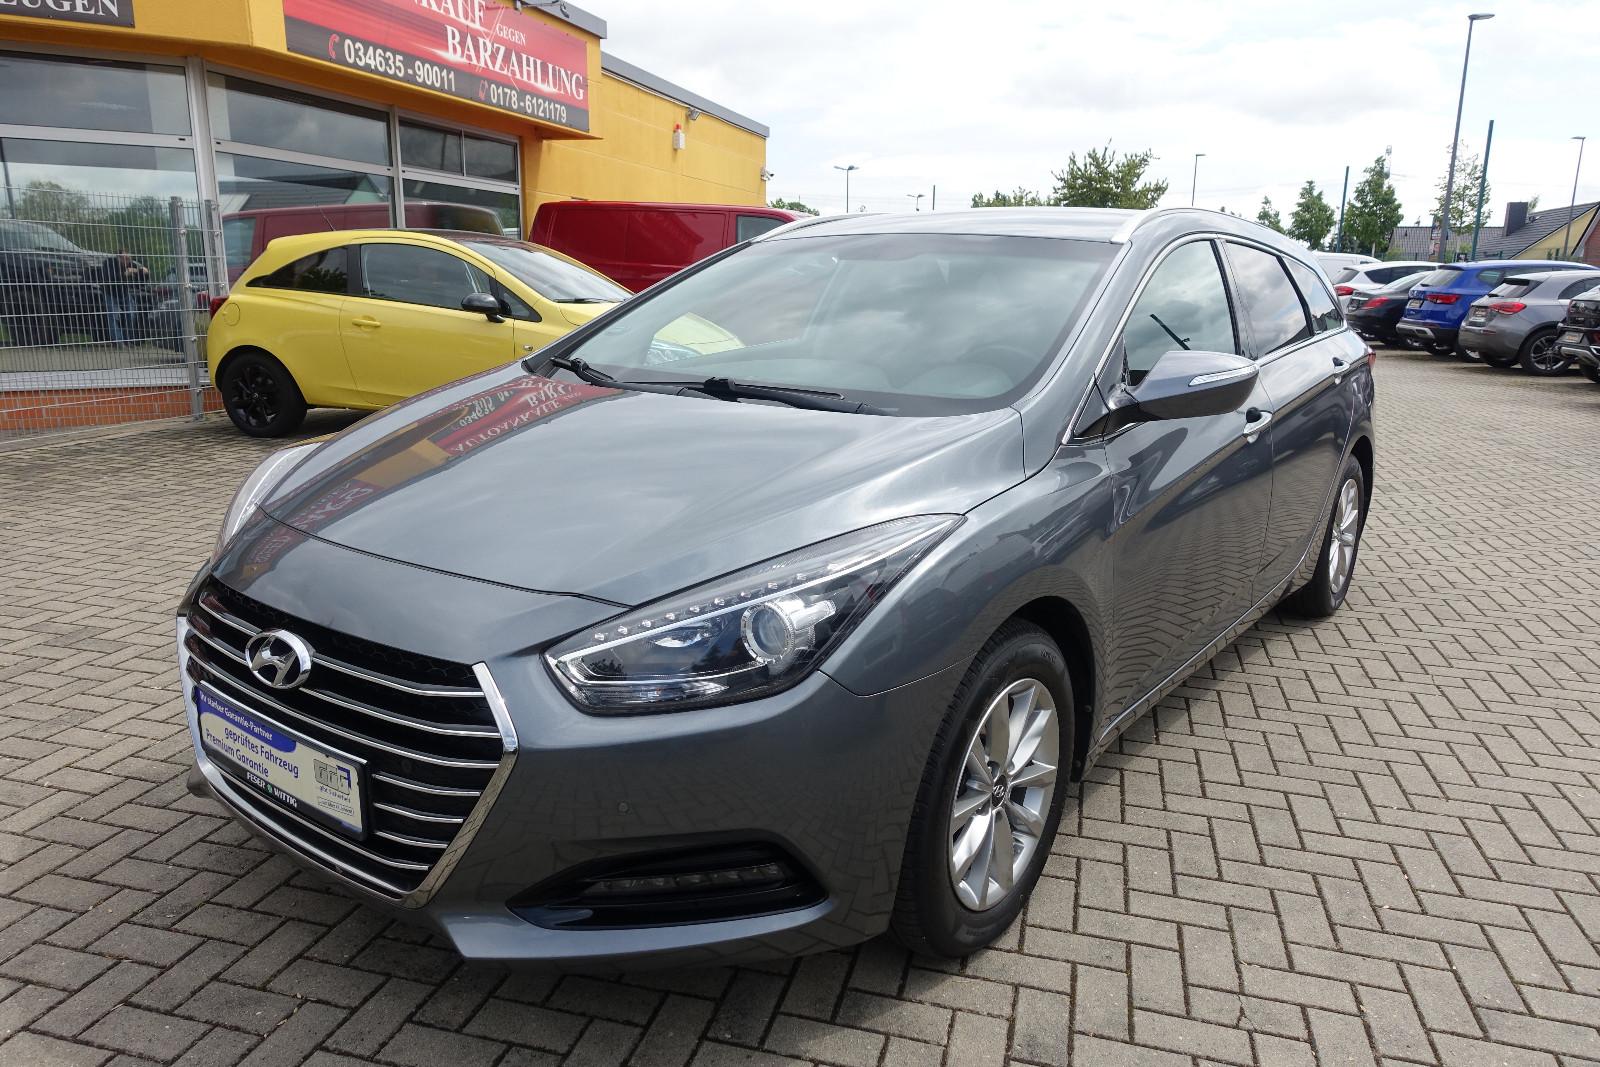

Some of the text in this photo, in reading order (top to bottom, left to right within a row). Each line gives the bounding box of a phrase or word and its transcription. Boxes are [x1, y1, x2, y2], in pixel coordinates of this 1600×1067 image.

[0, 0, 119, 17] GEN
[415, 0, 486, 29] AUF
[496, 24, 526, 45] GEGEN
[445, 24, 584, 100] BARZAHLUNG
[224, 706, 273, 740] Garantie-Partner
[206, 728, 269, 777] Premium Garantie
[224, 727, 259, 755] geprüftes
[260, 745, 299, 779] Fahrzeug
